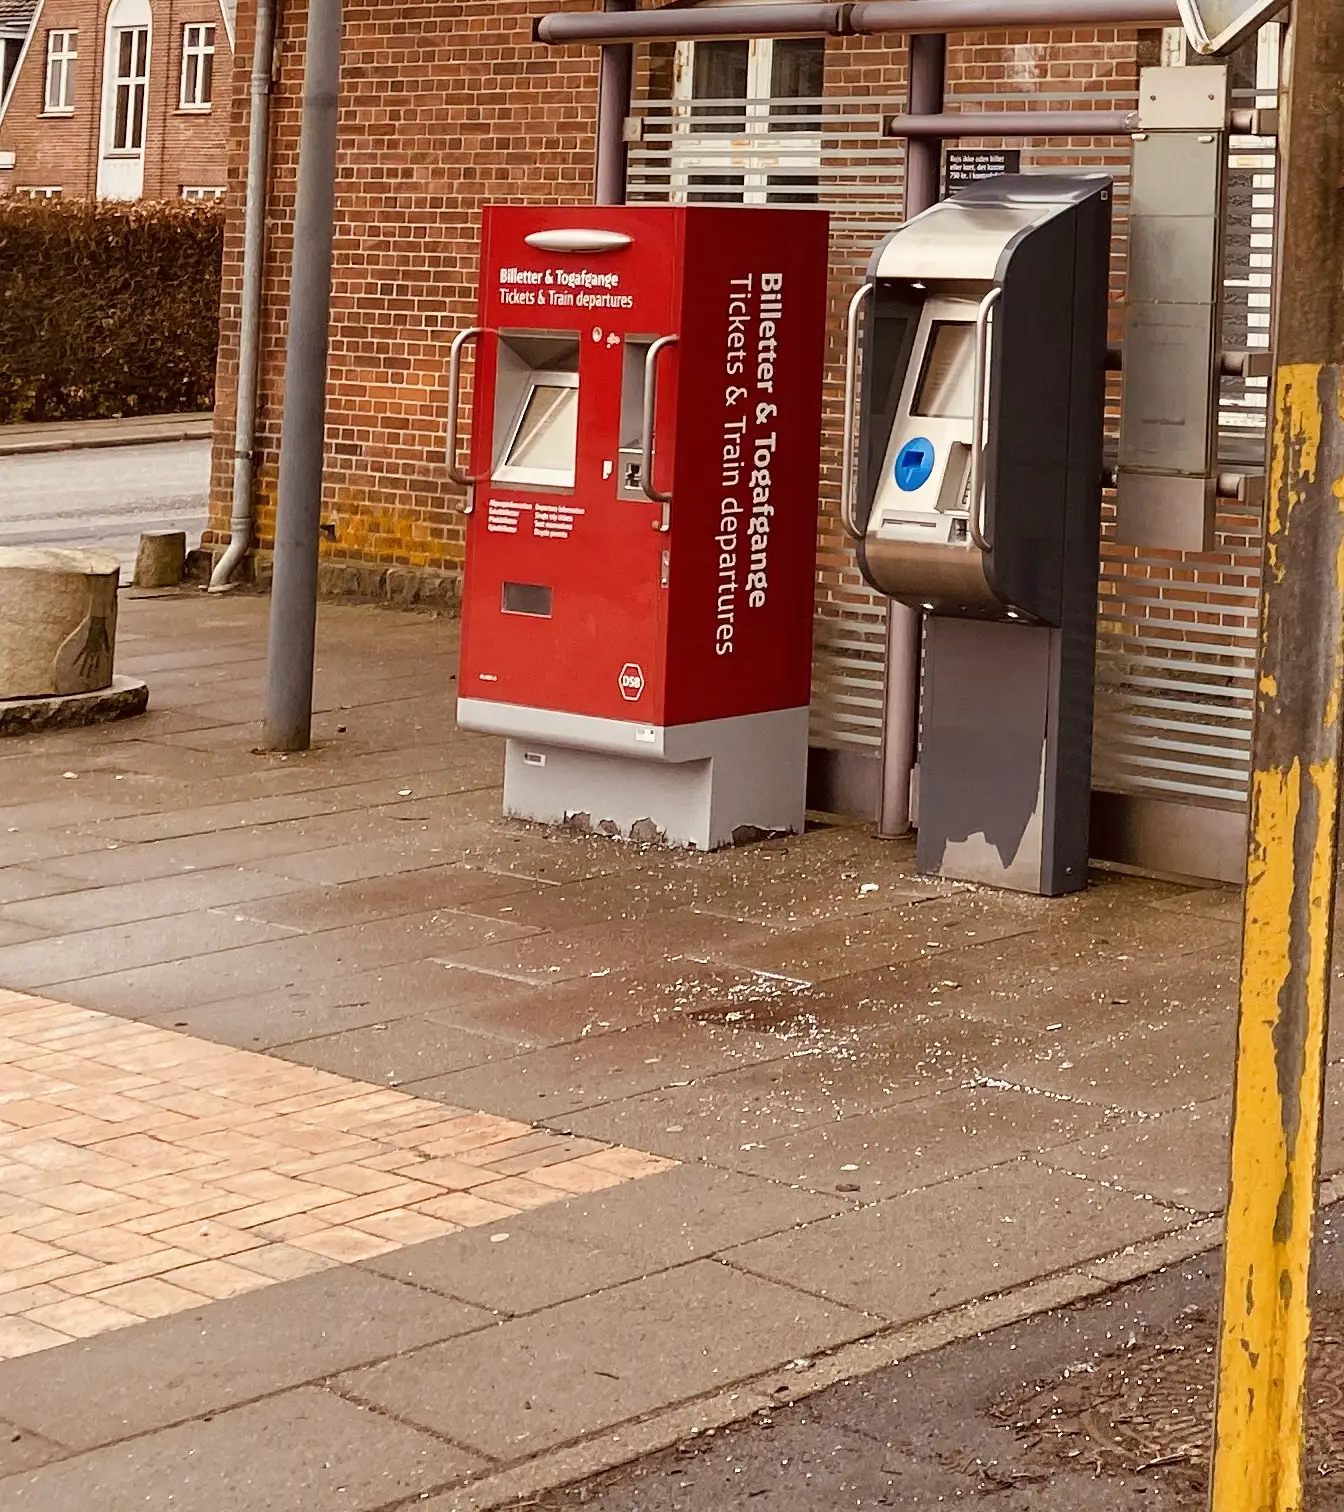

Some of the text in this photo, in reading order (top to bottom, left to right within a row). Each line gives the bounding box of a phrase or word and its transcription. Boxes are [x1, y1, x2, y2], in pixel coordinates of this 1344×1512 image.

[500, 267, 619, 289] Billetter & Togafgange
[499, 288, 633, 310] Tickets & Train departures
[745, 273, 783, 608] Billetter & Togafgange
[715, 273, 752, 655] Tickets & Train departures
[622, 675, 641, 688] DSB
